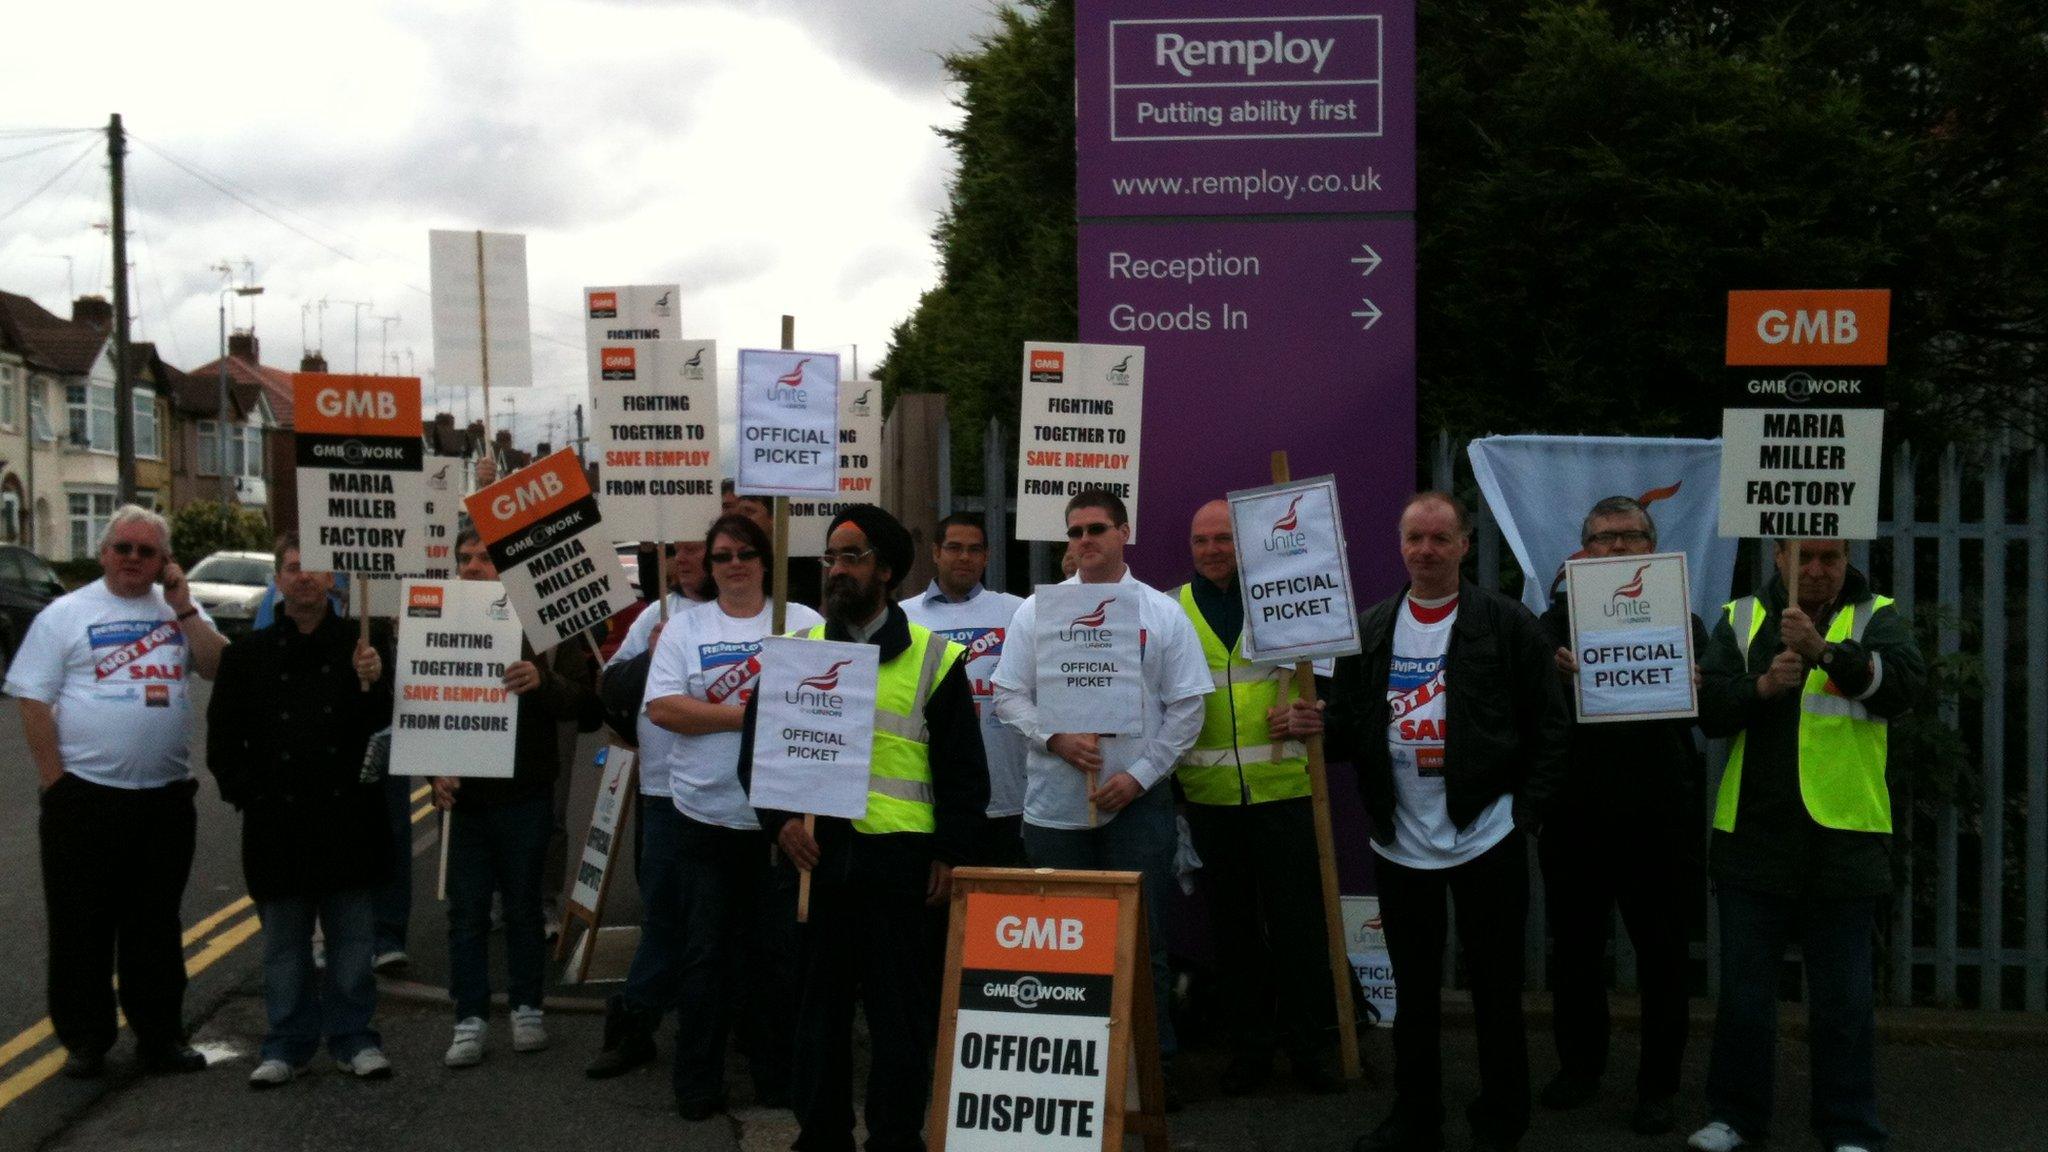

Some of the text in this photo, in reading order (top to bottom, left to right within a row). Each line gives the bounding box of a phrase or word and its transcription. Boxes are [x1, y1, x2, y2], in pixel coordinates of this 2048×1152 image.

[1155, 31, 1335, 77] Remploy
[1137, 98, 1357, 126] Putting ability first
[1112, 167, 1382, 200] www.remploy.co.uk
[1109, 249, 1259, 284] Reception
[1109, 303, 1248, 332] Goods In
[1757, 309, 1859, 345] GMB
[1034, 359, 1060, 369] GMB
[767, 386, 808, 401] unite
[1748, 371, 1862, 402] GMB@WORK
[315, 388, 397, 419] GMB
[623, 395, 690, 412] FIGHTING
[1048, 398, 1114, 415] FIGHTING
[610, 424, 705, 441] TOGETHER TO
[745, 426, 830, 445] OFFICIAL
[1034, 426, 1126, 444] TOGETHER TO
[1763, 413, 1845, 438] MARIA
[606, 451, 710, 467] SAVE REMPLOY
[754, 448, 822, 465] PICKET
[852, 455, 868, 468] TO
[1026, 450, 1130, 469] SAVE REMPLOY
[1759, 445, 1846, 470] MILLER
[328, 473, 394, 494] MARIA
[606, 479, 713, 496] FROM CLOSURE
[1024, 479, 1064, 496] FROM
[1746, 480, 1857, 506] FACTORY
[492, 471, 564, 521] GMB
[328, 498, 396, 519] MILLER
[788, 503, 815, 516] ROM
[430, 525, 445, 537] TO
[1759, 511, 1839, 537] KILLER
[320, 526, 406, 548] FACTORY
[1264, 530, 1306, 552] unite
[332, 552, 396, 572] KILLER
[526, 538, 586, 578] MARIA
[534, 557, 596, 599] MILLER
[1251, 573, 1338, 600] OFFICIAL
[537, 575, 611, 625] FACTORY
[1263, 597, 1332, 623] PICKET
[1603, 598, 1651, 617] unite
[555, 600, 612, 639] KILLER
[426, 632, 493, 650] FIGHTING
[1060, 627, 1113, 642] unite
[100, 646, 139, 674] NOT
[1583, 643, 1683, 665] OFFICIAL
[411, 660, 506, 678] TOGETHER TO
[1060, 662, 1118, 673] OFFICIAL
[1595, 667, 1673, 688] PICKET
[710, 660, 754, 697] NOT
[1067, 677, 1113, 687] PICKET
[403, 684, 510, 703] SAVE REMPLOY
[785, 690, 843, 709] unite
[1391, 688, 1420, 716] OT
[400, 714, 509, 732] FROM CLOSURE
[783, 728, 847, 746] OFFICIAL
[788, 746, 839, 762] PICKET
[995, 915, 1084, 951] GMB
[983, 976, 1086, 1009] GMB@WORK
[960, 1032, 1100, 1077] OFFICIAL
[955, 1092, 1094, 1139] DISPUTE
